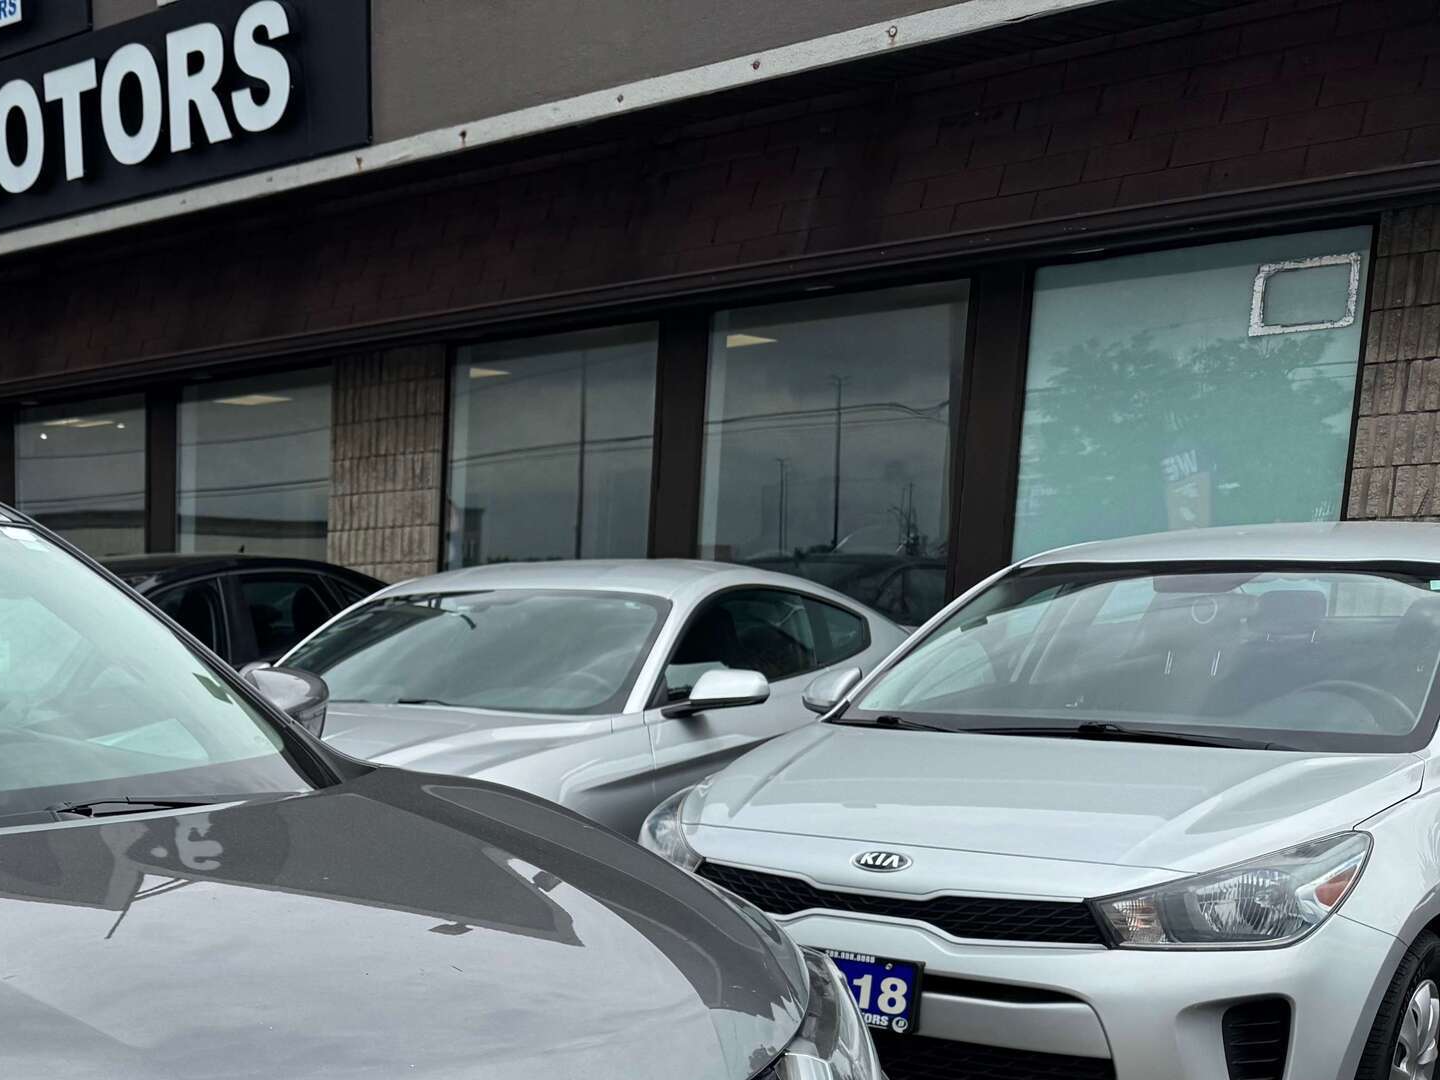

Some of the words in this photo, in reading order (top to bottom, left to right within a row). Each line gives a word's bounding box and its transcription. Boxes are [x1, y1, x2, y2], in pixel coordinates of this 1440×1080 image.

[860, 853, 900, 867] KIA
[853, 974, 908, 1015] 18
[863, 1013, 889, 1026] ORS
